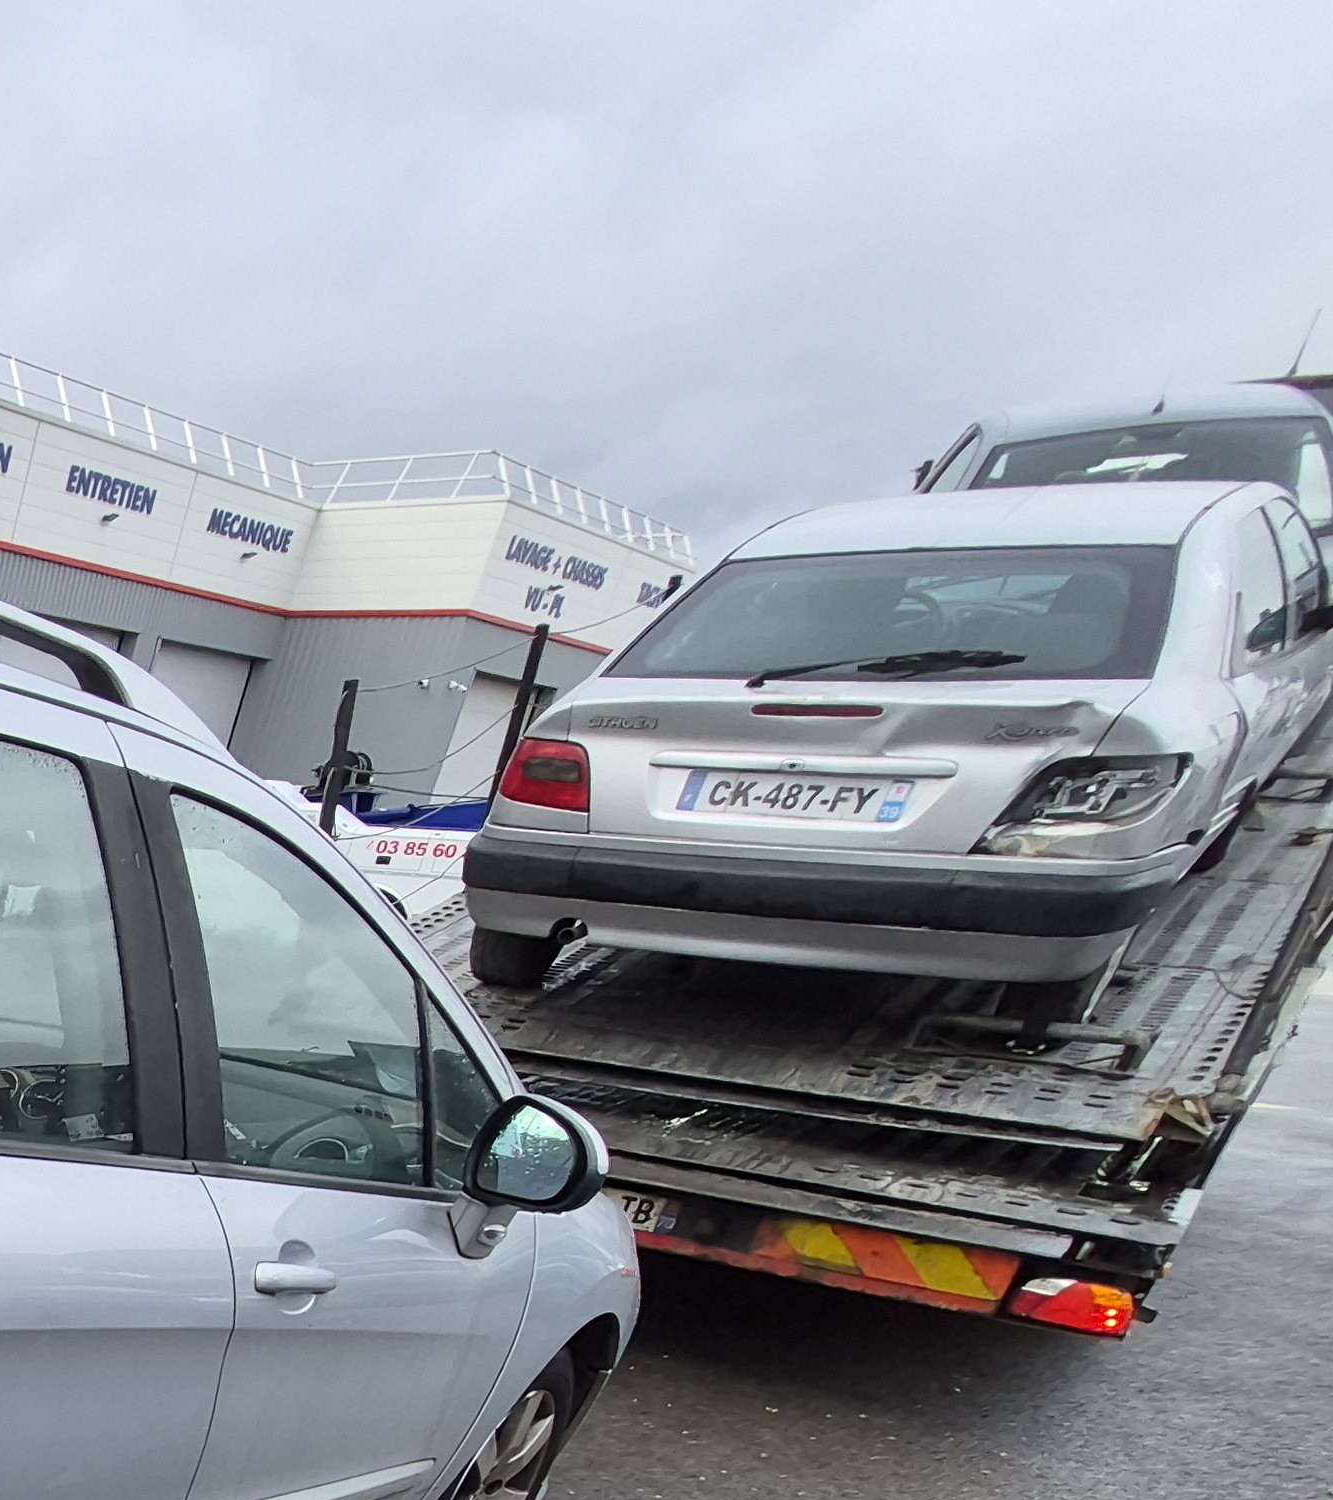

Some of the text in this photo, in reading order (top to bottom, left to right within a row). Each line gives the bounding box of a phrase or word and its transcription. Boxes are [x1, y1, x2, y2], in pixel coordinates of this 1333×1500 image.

[65, 464, 158, 516] ENTRETIEN
[206, 507, 294, 554] MECANIQUE
[505, 534, 555, 573] LAVAGE
[707, 779, 880, 814] CK-487-FY
[877, 805, 900, 819] 39
[376, 840, 457, 858] 03 85 60
[621, 1195, 655, 1224] TB
